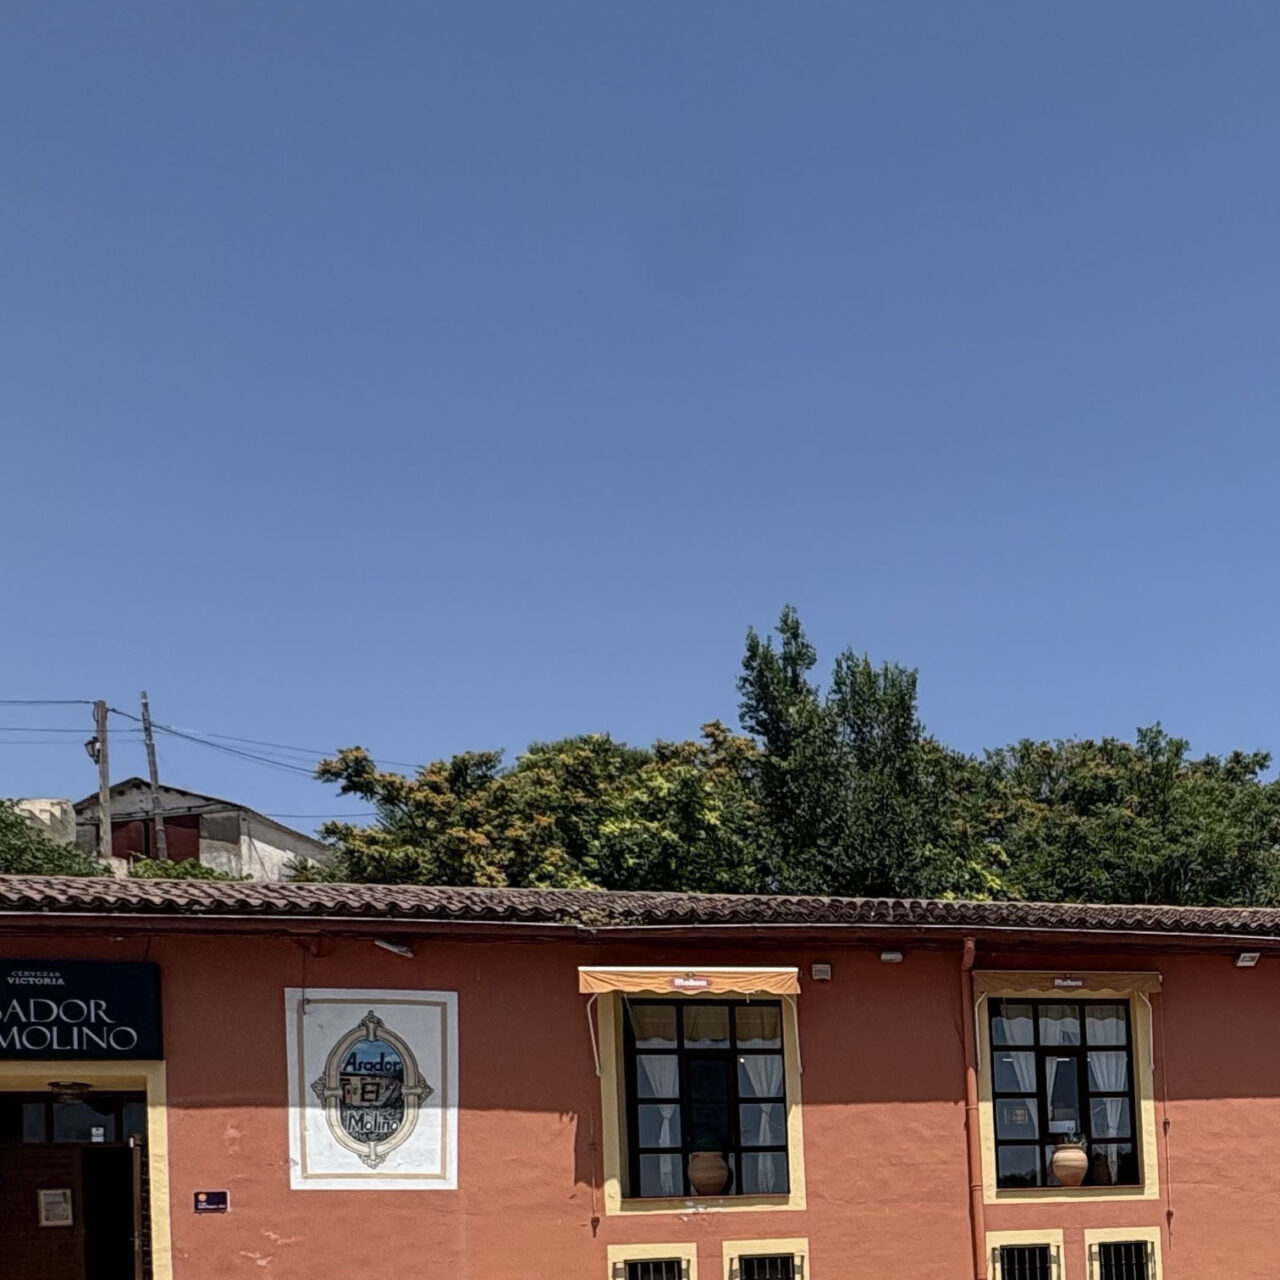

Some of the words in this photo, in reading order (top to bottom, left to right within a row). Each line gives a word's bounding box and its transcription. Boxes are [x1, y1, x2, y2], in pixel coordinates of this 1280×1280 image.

[7, 976, 66, 985] VICTORIA
[0, 998, 116, 1023] ADOR
[343, 1051, 402, 1073] Asador
[346, 1110, 400, 1133] Molino
